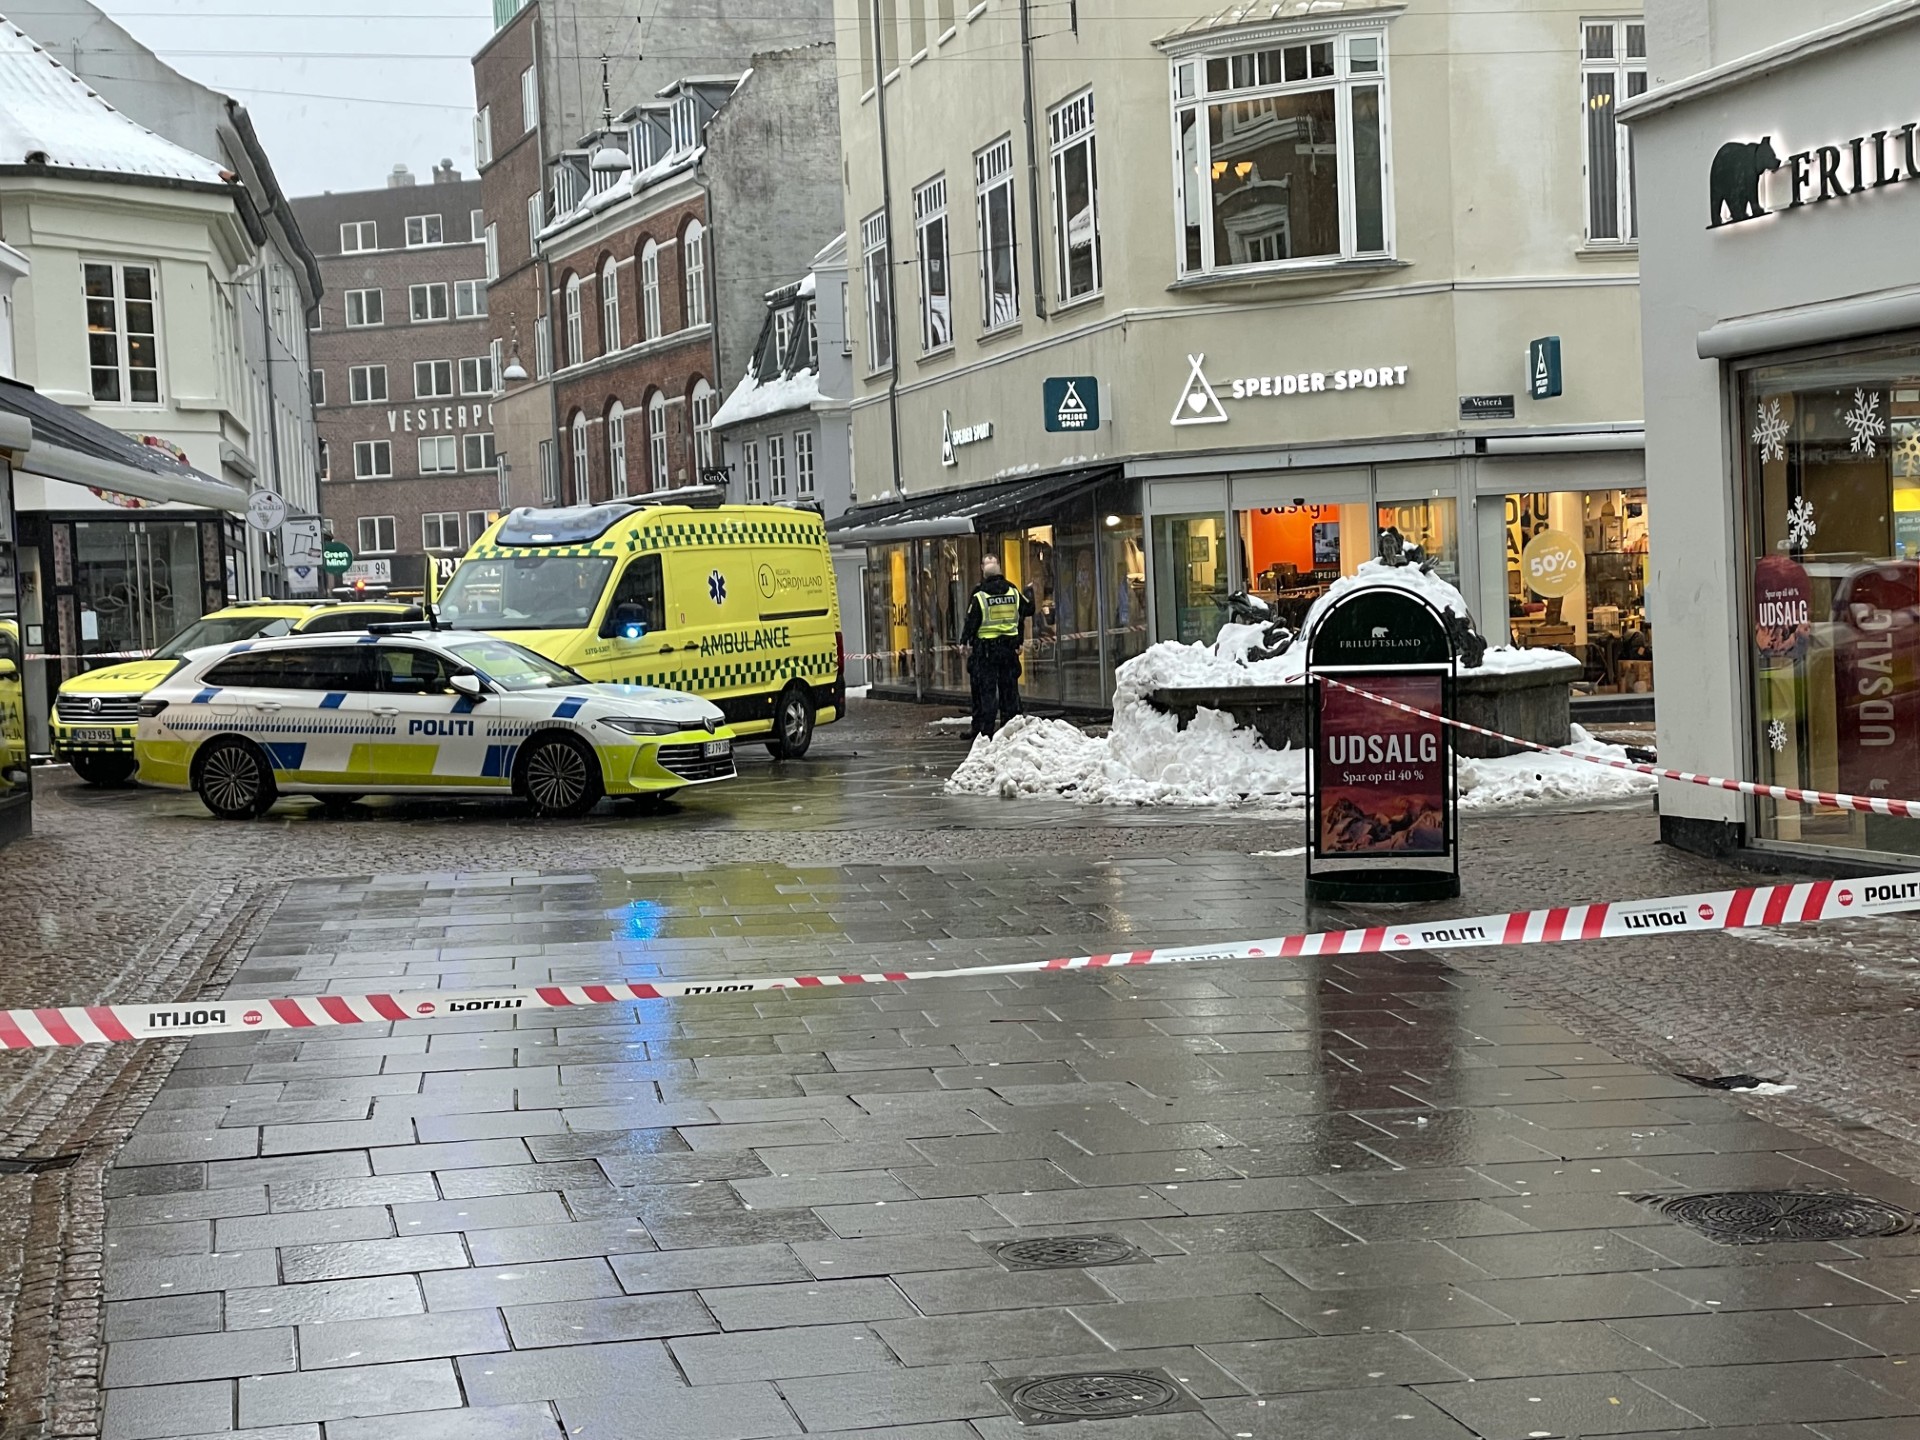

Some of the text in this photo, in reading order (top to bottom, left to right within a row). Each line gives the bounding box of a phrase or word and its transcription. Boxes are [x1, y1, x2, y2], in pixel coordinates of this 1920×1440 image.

[1232, 365, 1408, 399] SPEJDER SPORT
[1472, 397, 1502, 406] Vesterå
[1058, 413, 1088, 421] SPEJDER
[1061, 420, 1085, 428] SPORT
[323, 550, 349, 559] Green
[326, 558, 347, 567] Mind
[1530, 549, 1577, 577] 50%
[777, 575, 823, 590] NORDJYLLAND
[988, 596, 1015, 605] POLITI
[1759, 600, 1808, 627] UDSALG
[701, 626, 790, 658] AMBULANCE
[1340, 638, 1421, 649] FRILUFTSLAND
[1855, 608, 1896, 746] UDSALG
[408, 720, 474, 736] POLITI
[1328, 733, 1437, 764] UDSALG
[1343, 769, 1424, 785] Spar op til 40 %
[1624, 911, 1687, 928] POLITI
[1421, 926, 1486, 943] POLITI
